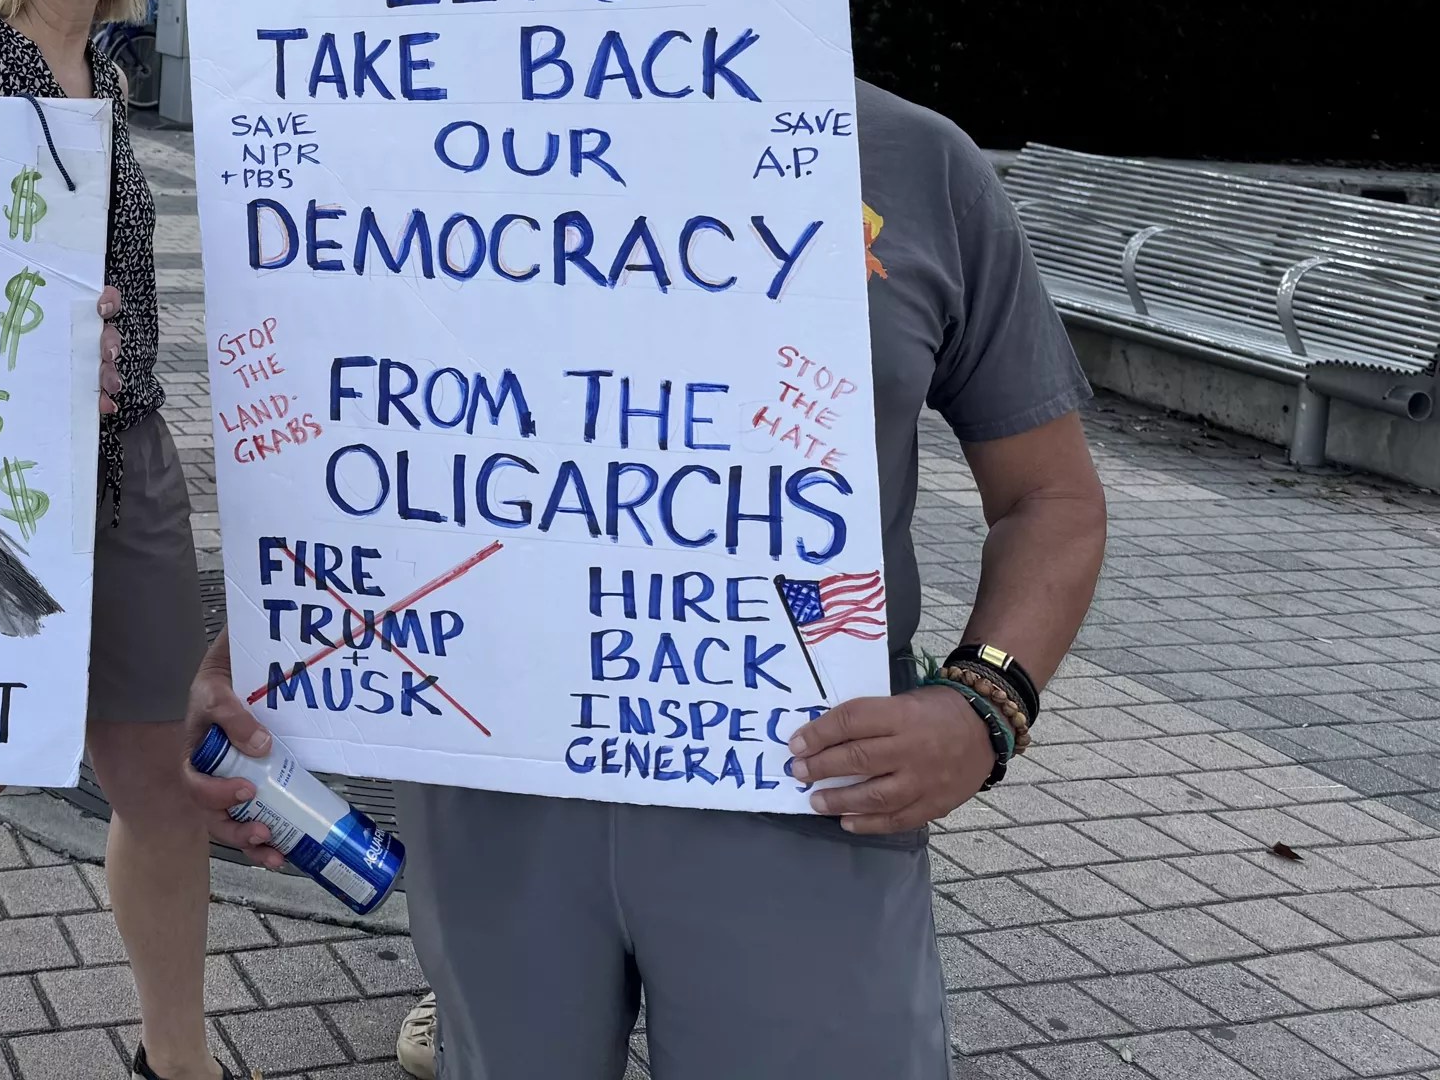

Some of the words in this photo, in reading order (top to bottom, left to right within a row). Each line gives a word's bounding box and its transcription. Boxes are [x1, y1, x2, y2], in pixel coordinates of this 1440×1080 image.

[257, 28, 448, 99] TAKE
[520, 25, 762, 102] BACK
[231, 112, 317, 138] SAVE
[770, 108, 852, 136] SAVE
[242, 143, 320, 166] NPR
[434, 121, 627, 187] OUR
[246, 198, 824, 301] DEMOCRACY
[218, 317, 277, 365] STOP
[233, 353, 286, 388] THE
[776, 346, 857, 400] STOP
[330, 356, 536, 437] FROM
[563, 370, 731, 451] THE
[779, 381, 841, 429] THE
[233, 413, 323, 464] GRABS
[752, 406, 848, 471] HATE
[326, 443, 853, 565] OLIGARCHS
[259, 536, 385, 596] FIRE
[589, 567, 770, 623] HIRE
[263, 599, 464, 656] TRUMP
[266, 661, 442, 716] MUSK
[590, 629, 792, 693] BACK
